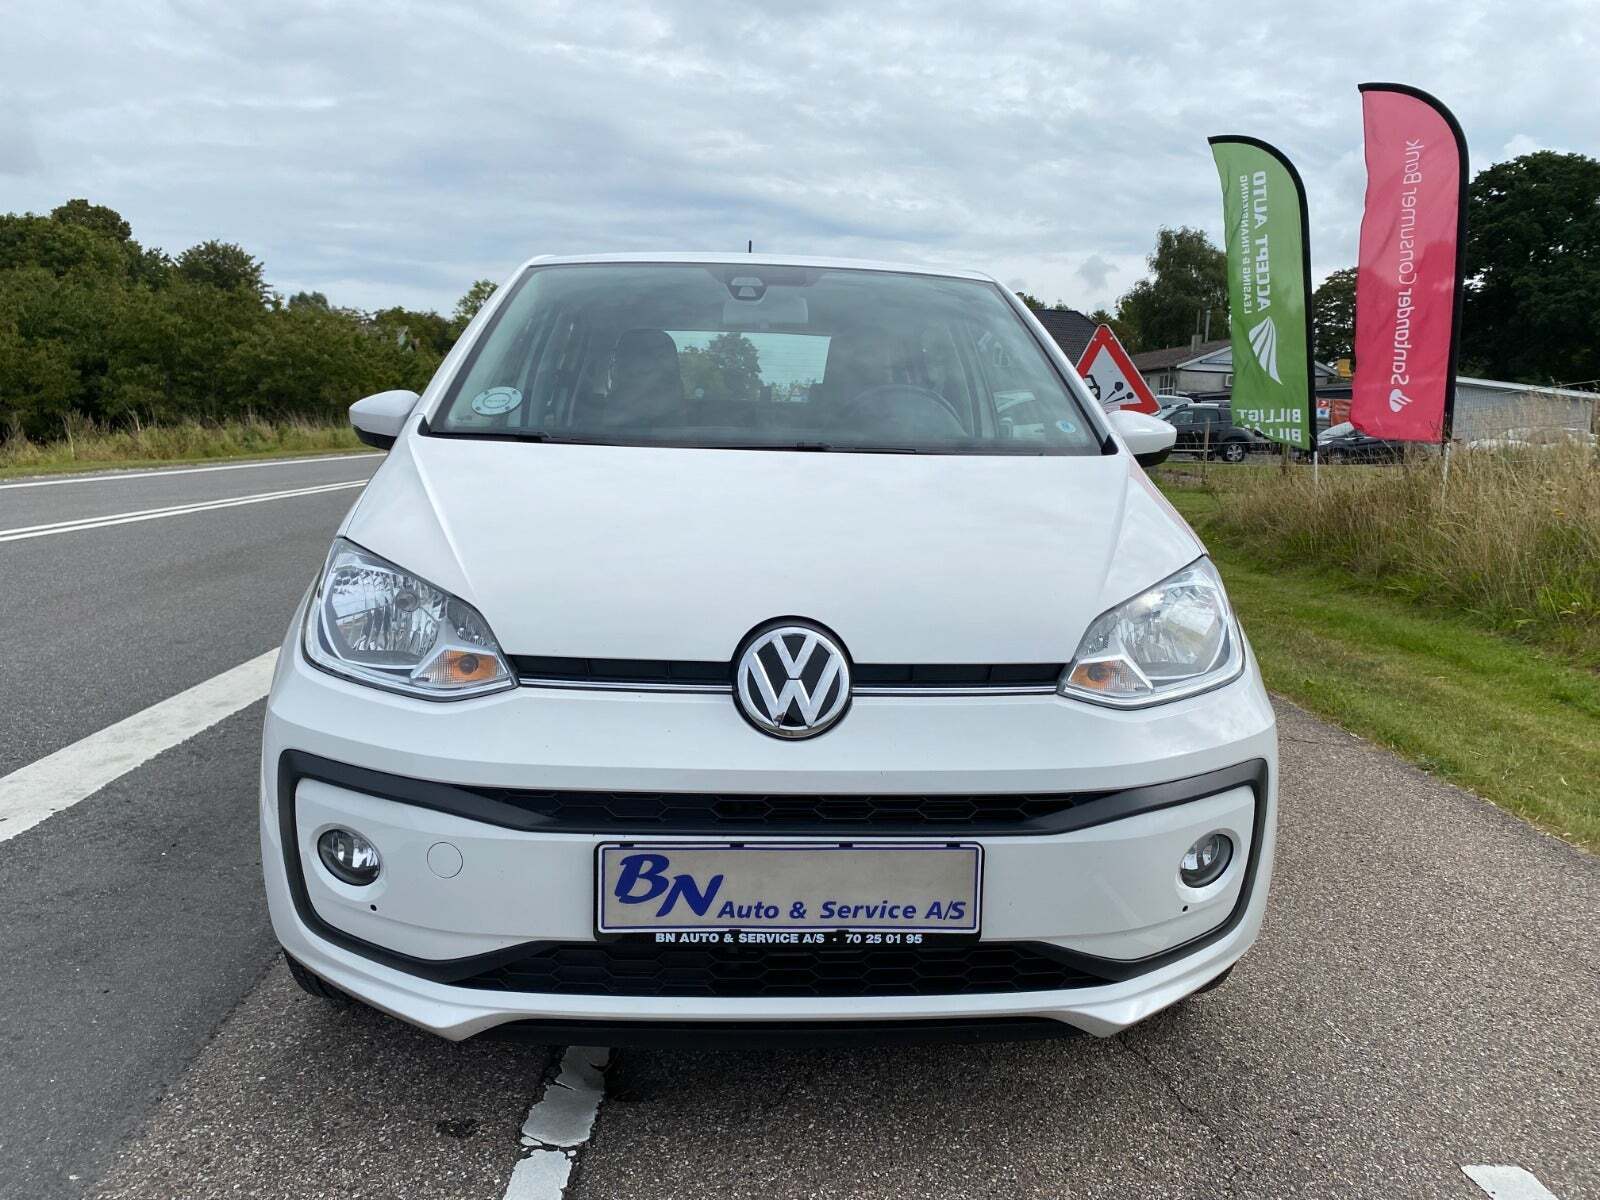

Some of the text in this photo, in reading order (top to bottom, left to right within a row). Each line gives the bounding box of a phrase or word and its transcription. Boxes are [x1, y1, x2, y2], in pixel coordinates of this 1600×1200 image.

[614, 853, 967, 920] BN Auto & Service A/S
[655, 933, 923, 944] BN AUTO & SERVICE A/S 70 25 01 95
